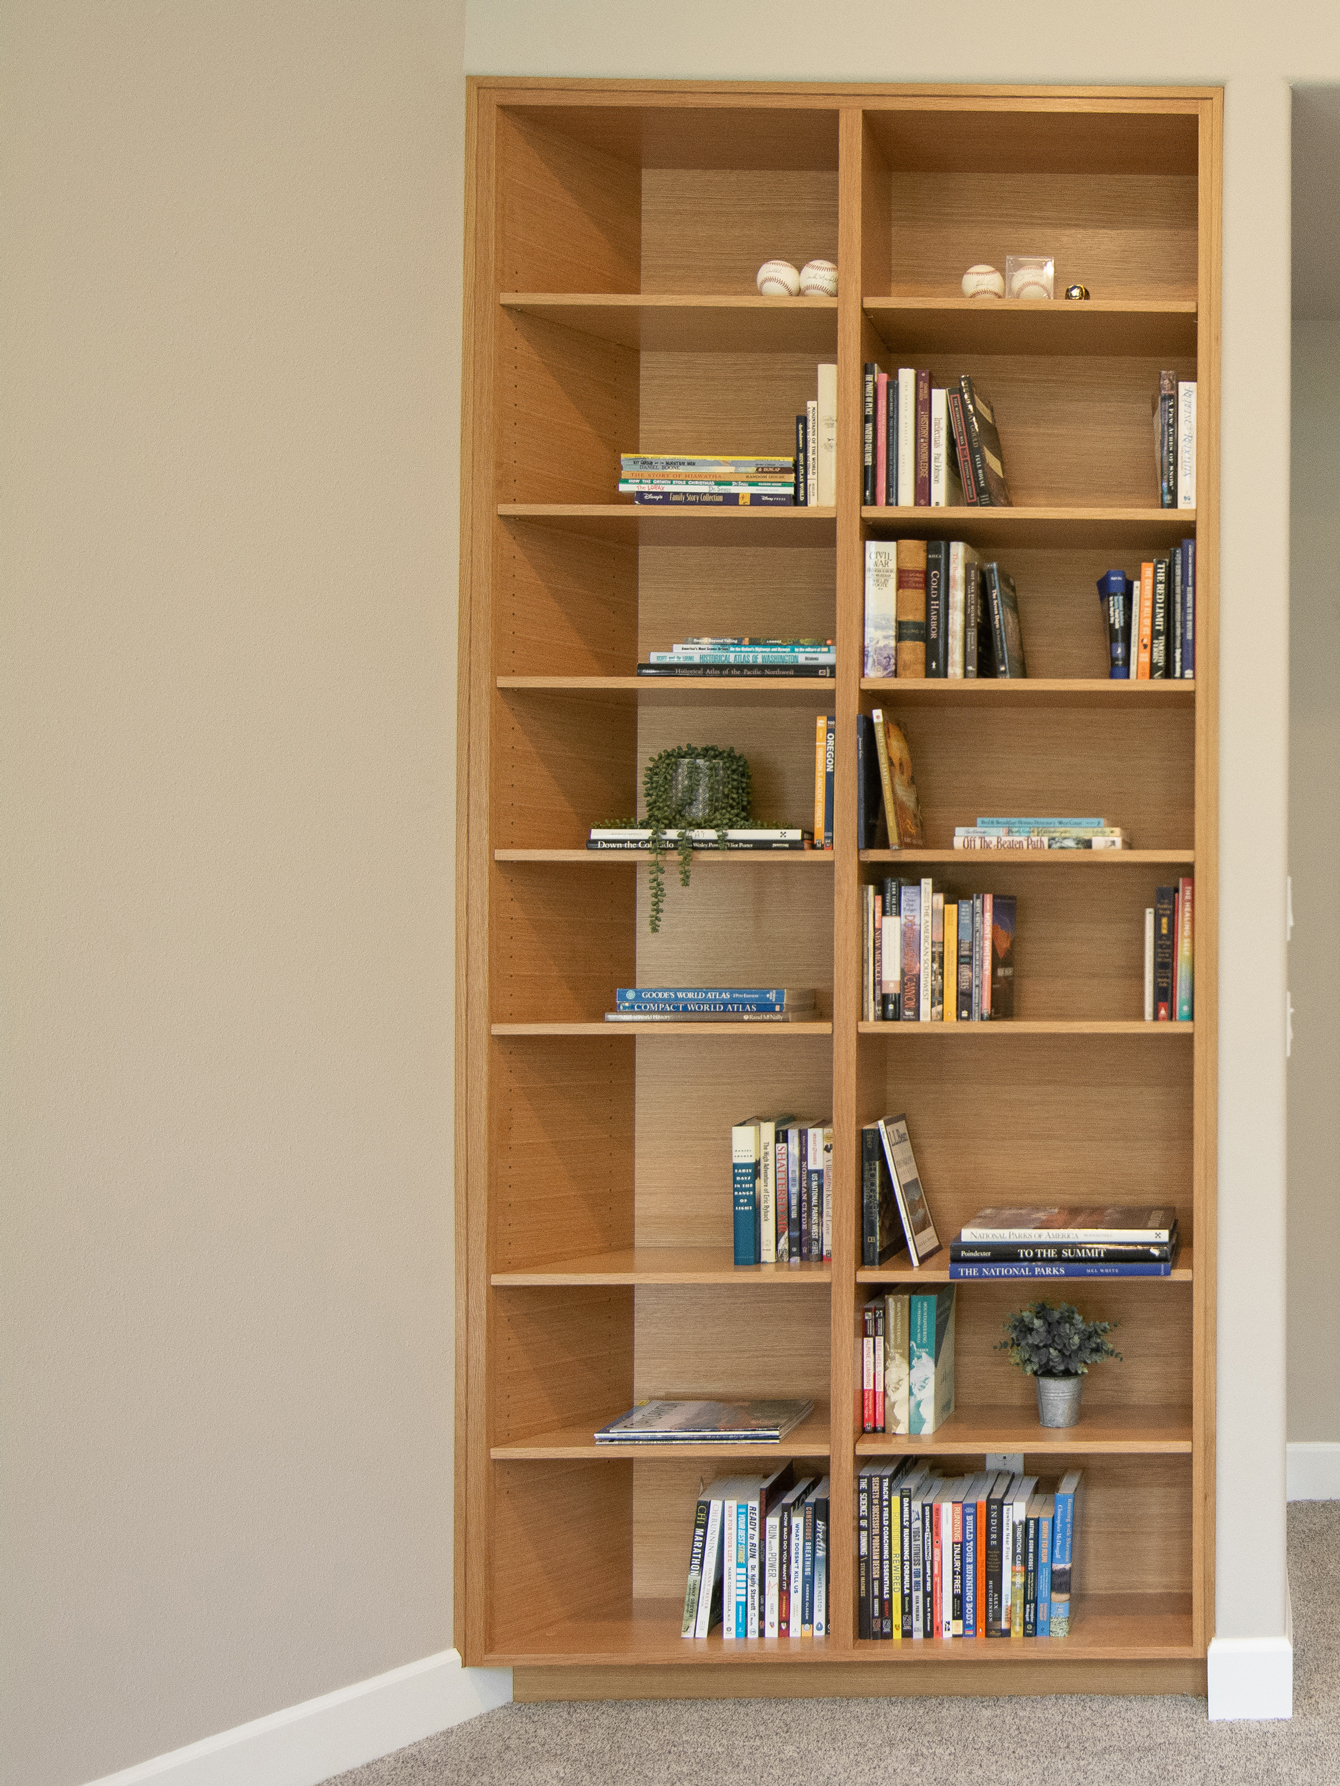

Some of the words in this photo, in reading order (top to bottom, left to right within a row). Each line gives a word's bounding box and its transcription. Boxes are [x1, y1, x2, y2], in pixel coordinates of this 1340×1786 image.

[934, 418, 942, 448] Intellectuals
[934, 464, 942, 484] Johnson
[670, 493, 686, 501] Family
[686, 493, 699, 502] Story
[700, 493, 723, 501] Collection
[1156, 563, 1165, 582] THE
[930, 571, 939, 597] COLD
[1156, 584, 1164, 602] RED
[930, 601, 939, 639] HARBOR
[1155, 602, 1164, 631] LIMIT
[700, 654, 731, 663] HISTORICAL
[734, 655, 750, 663] ATLAS
[752, 655, 759, 663] OF
[762, 654, 799, 663] WASHINGTON
[963, 837, 976, 849] Off
[978, 837, 992, 849] The
[994, 837, 1024, 849] Beaten
[1026, 837, 1045, 849] Path
[904, 915, 916, 942] DEATH
[904, 947, 915, 974] GRAND
[904, 976, 916, 1008] CANYON
[777, 1146, 786, 1212] SHATTERED
[778, 1214, 786, 1234] AIR
[1018, 1249, 1033, 1258] TO
[1035, 1249, 1057, 1258] THE
[1062, 1249, 1106, 1257] SUMMIT
[958, 1268, 979, 1276] THE
[982, 1268, 1032, 1276] NATIONAL
[1035, 1267, 1065, 1275] PARKS
[697, 1506, 706, 1524] CHI
[860, 1520, 868, 1528] OF
[768, 1525, 777, 1539] RUN
[690, 1528, 704, 1576] MARATHON
[768, 1552, 776, 1578] POWER
